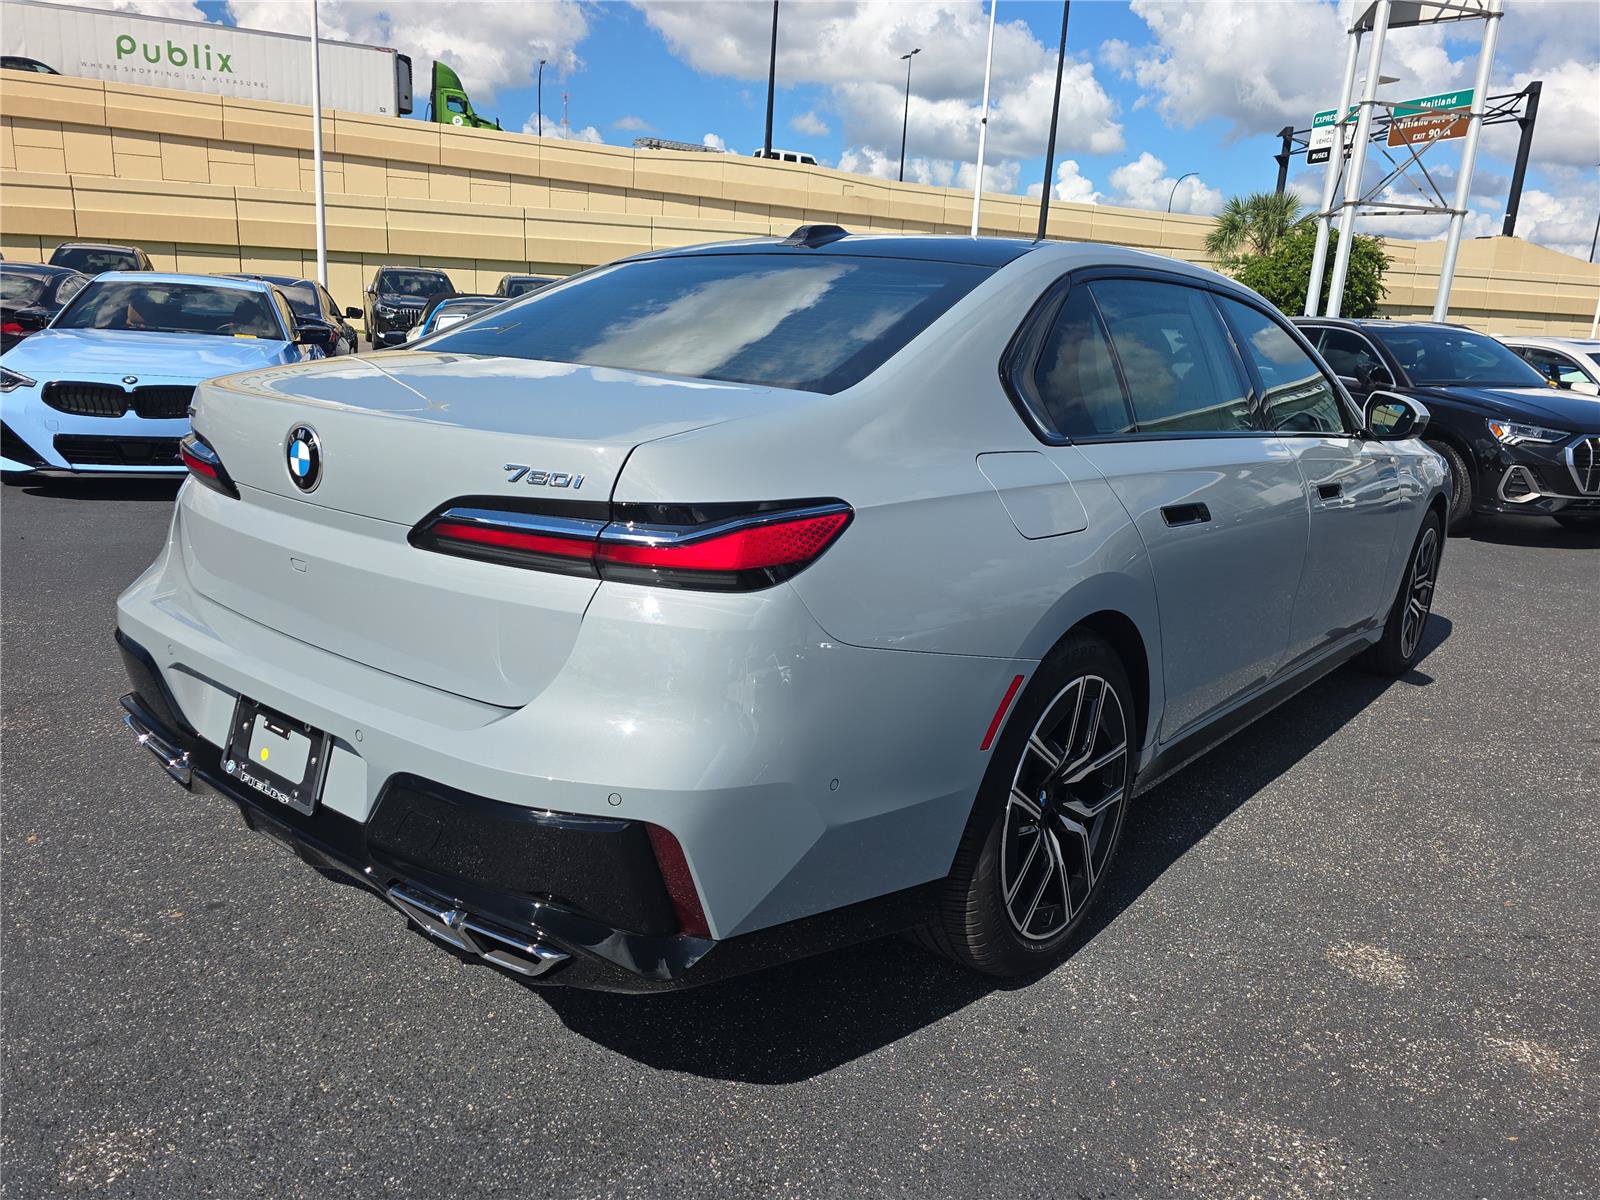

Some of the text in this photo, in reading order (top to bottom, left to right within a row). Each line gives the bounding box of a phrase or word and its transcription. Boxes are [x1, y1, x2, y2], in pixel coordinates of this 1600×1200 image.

[116, 34, 234, 73] Publix
[81, 61, 118, 71] WHERE
[124, 66, 180, 78] SHOPPING
[1420, 95, 1457, 108] Maitland
[1312, 151, 1328, 160] BUSES
[240, 771, 290, 804] FIELDS
